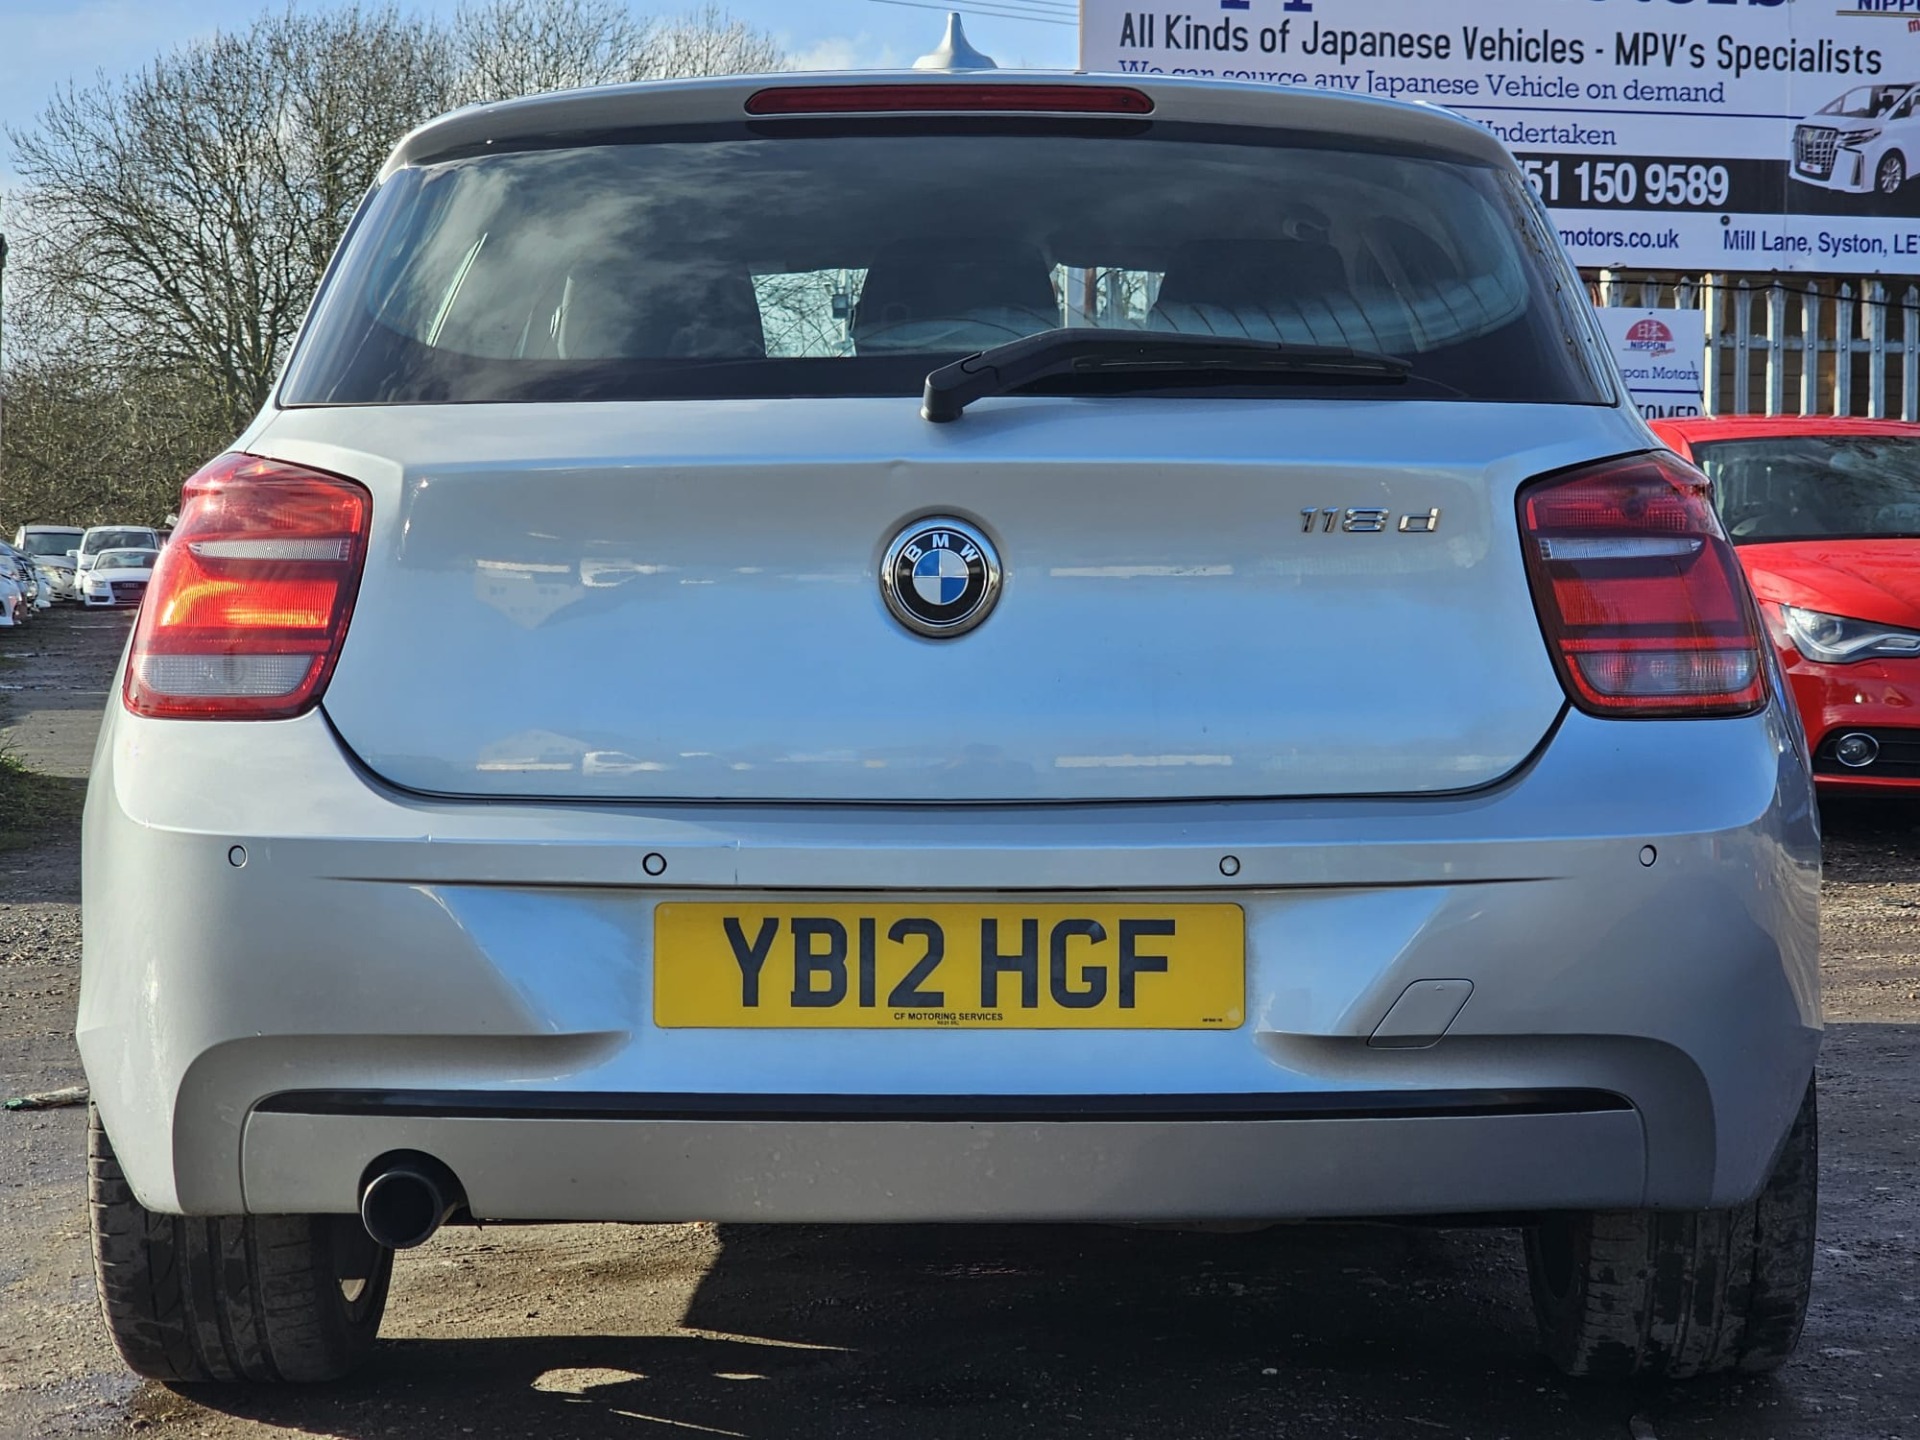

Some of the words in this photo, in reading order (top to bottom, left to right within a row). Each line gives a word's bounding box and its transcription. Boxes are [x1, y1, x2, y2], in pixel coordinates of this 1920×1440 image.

[1119, 12, 1154, 48] All
[1165, 14, 1249, 52] Kinds
[1259, 18, 1290, 53] of
[1302, 20, 1451, 65] Japanese
[1462, 26, 1585, 65] Vehicles
[1614, 31, 1705, 70] MPV's
[1717, 34, 1882, 78] Specialists
[1366, 70, 1479, 98] Japanese
[1485, 74, 1580, 98] Vehicle
[1586, 83, 1618, 100] on
[1623, 79, 1725, 103] demand
[1574, 161, 1637, 203] 150
[1644, 163, 1729, 206] 9589
[1723, 229, 1755, 250] Mill
[1762, 230, 1812, 256] Lane,
[1818, 231, 1888, 258] Syston,
[1894, 234, 1920, 254] LE
[1630, 341, 1666, 350] NIPPON
[1652, 366, 1699, 380] Motors
[903, 533, 979, 563] BMW
[722, 917, 945, 1008] YB12
[980, 918, 1176, 1009] HGF
[894, 1012, 906, 1021] CF
[908, 1012, 957, 1021] MOTORING
[958, 1012, 1004, 1021] SERVICES
